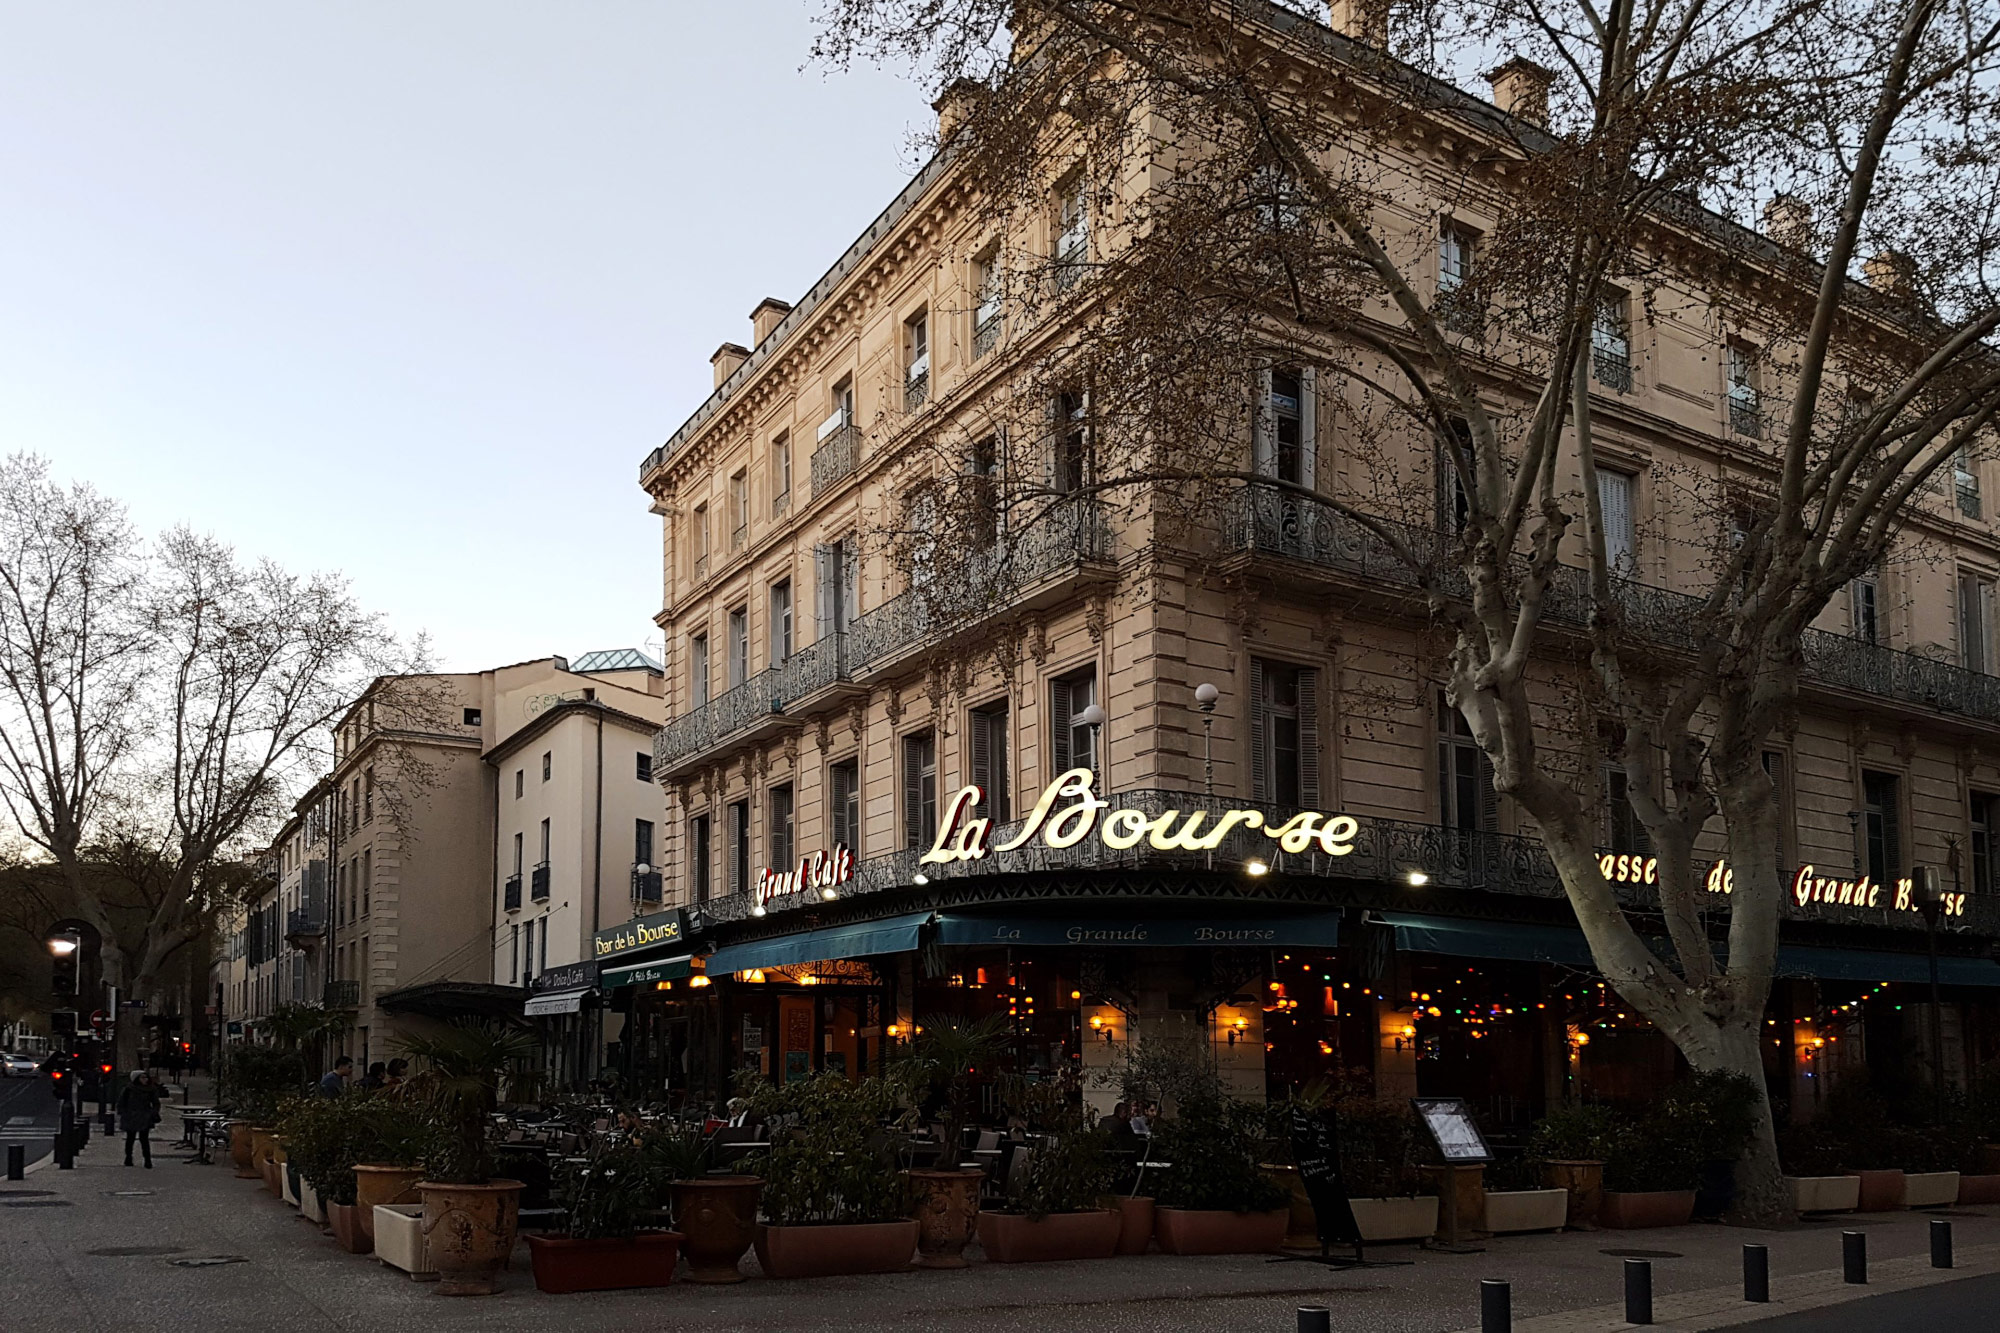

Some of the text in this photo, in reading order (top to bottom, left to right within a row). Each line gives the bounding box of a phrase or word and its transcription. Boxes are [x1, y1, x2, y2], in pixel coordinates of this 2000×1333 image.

[920, 767, 1359, 866] La Bourse
[756, 842, 850, 907] Grand Café
[1707, 859, 1733, 894] de
[1796, 865, 1880, 908] Grande
[595, 936, 613, 955] Bar
[614, 933, 626, 950] de
[626, 930, 636, 947] la
[637, 921, 679, 945] Bourse
[991, 923, 1275, 943] La Grande Bourse
